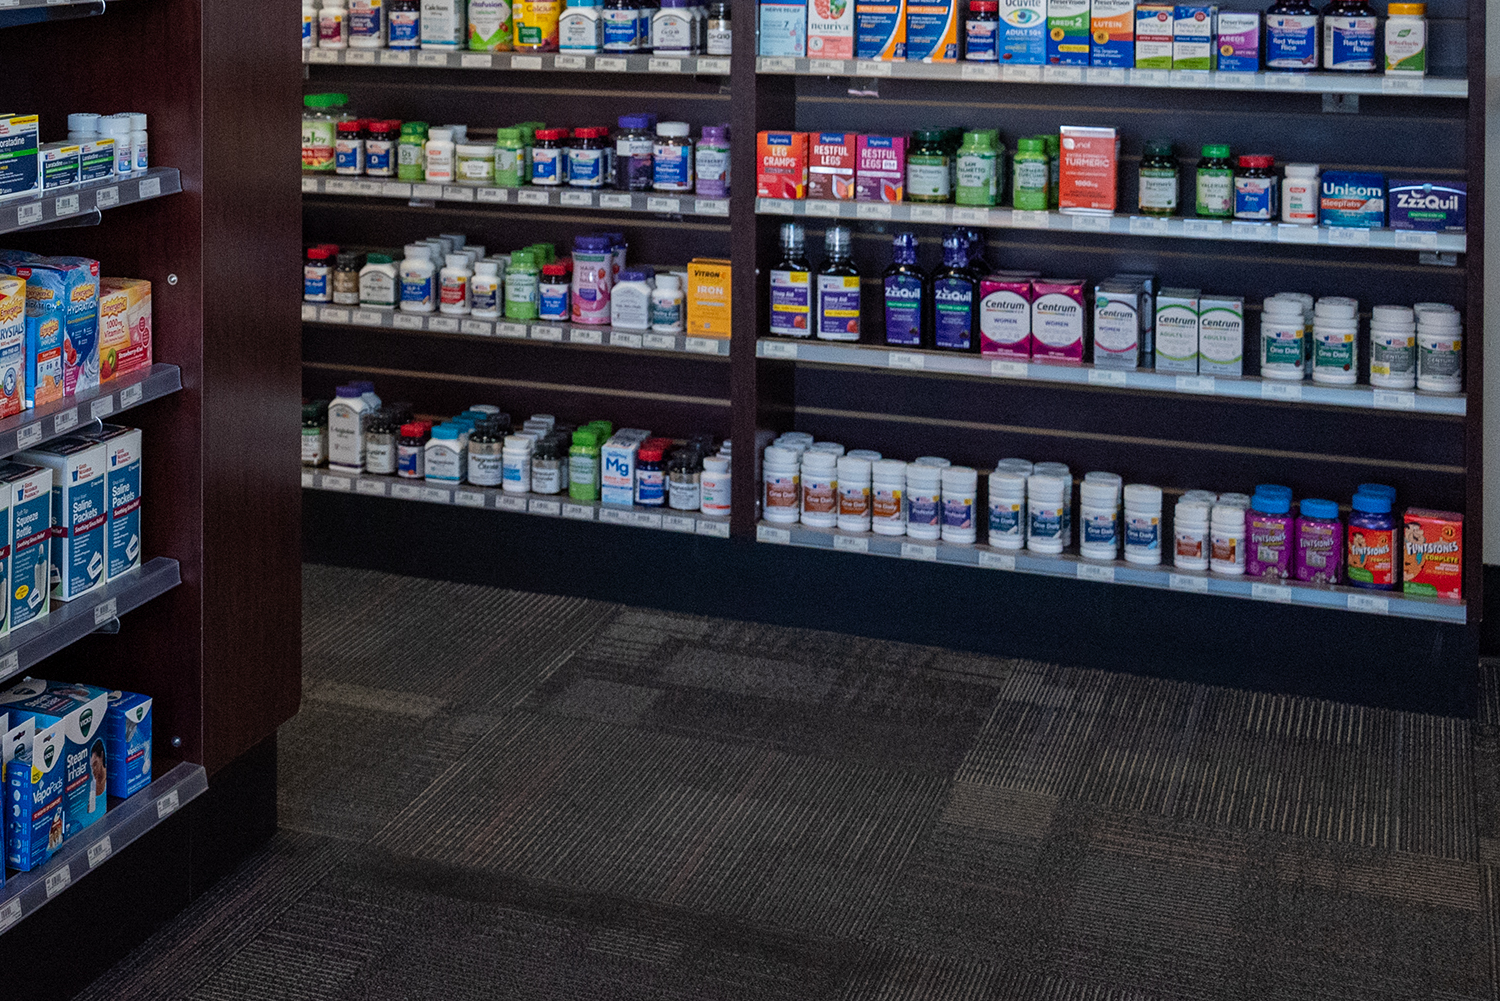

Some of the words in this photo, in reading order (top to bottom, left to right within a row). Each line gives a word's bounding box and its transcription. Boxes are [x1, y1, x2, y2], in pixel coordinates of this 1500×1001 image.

[811, 22, 849, 31] neuriva
[1094, 20, 1122, 28] LUTEIN
[772, 148, 787, 156] LEG
[814, 146, 848, 156] RESTFUL
[862, 149, 897, 159] RESTFUL
[764, 157, 796, 167] CRAMPS
[821, 156, 840, 166] LEGS
[1064, 157, 1110, 168] TURMERIC
[1323, 183, 1382, 197] Unisom
[1322, 200, 1361, 209] SleepTabs
[1397, 193, 1459, 211] ZzzQuil
[697, 284, 724, 296] IRON
[885, 286, 921, 300] ZzzQuil
[985, 299, 1025, 313] Centrum
[1036, 300, 1077, 314] Centrum
[1098, 307, 1132, 320] Centrum
[1158, 315, 1196, 326] Centrum
[1201, 318, 1240, 329] Centrum
[605, 456, 630, 477] Mg
[72, 498, 92, 514] Saline
[16, 511, 39, 527] Squeeze
[1406, 541, 1459, 555] FLINTSTONES
[66, 748, 88, 766] Steam
[67, 763, 87, 782] Inhaler
